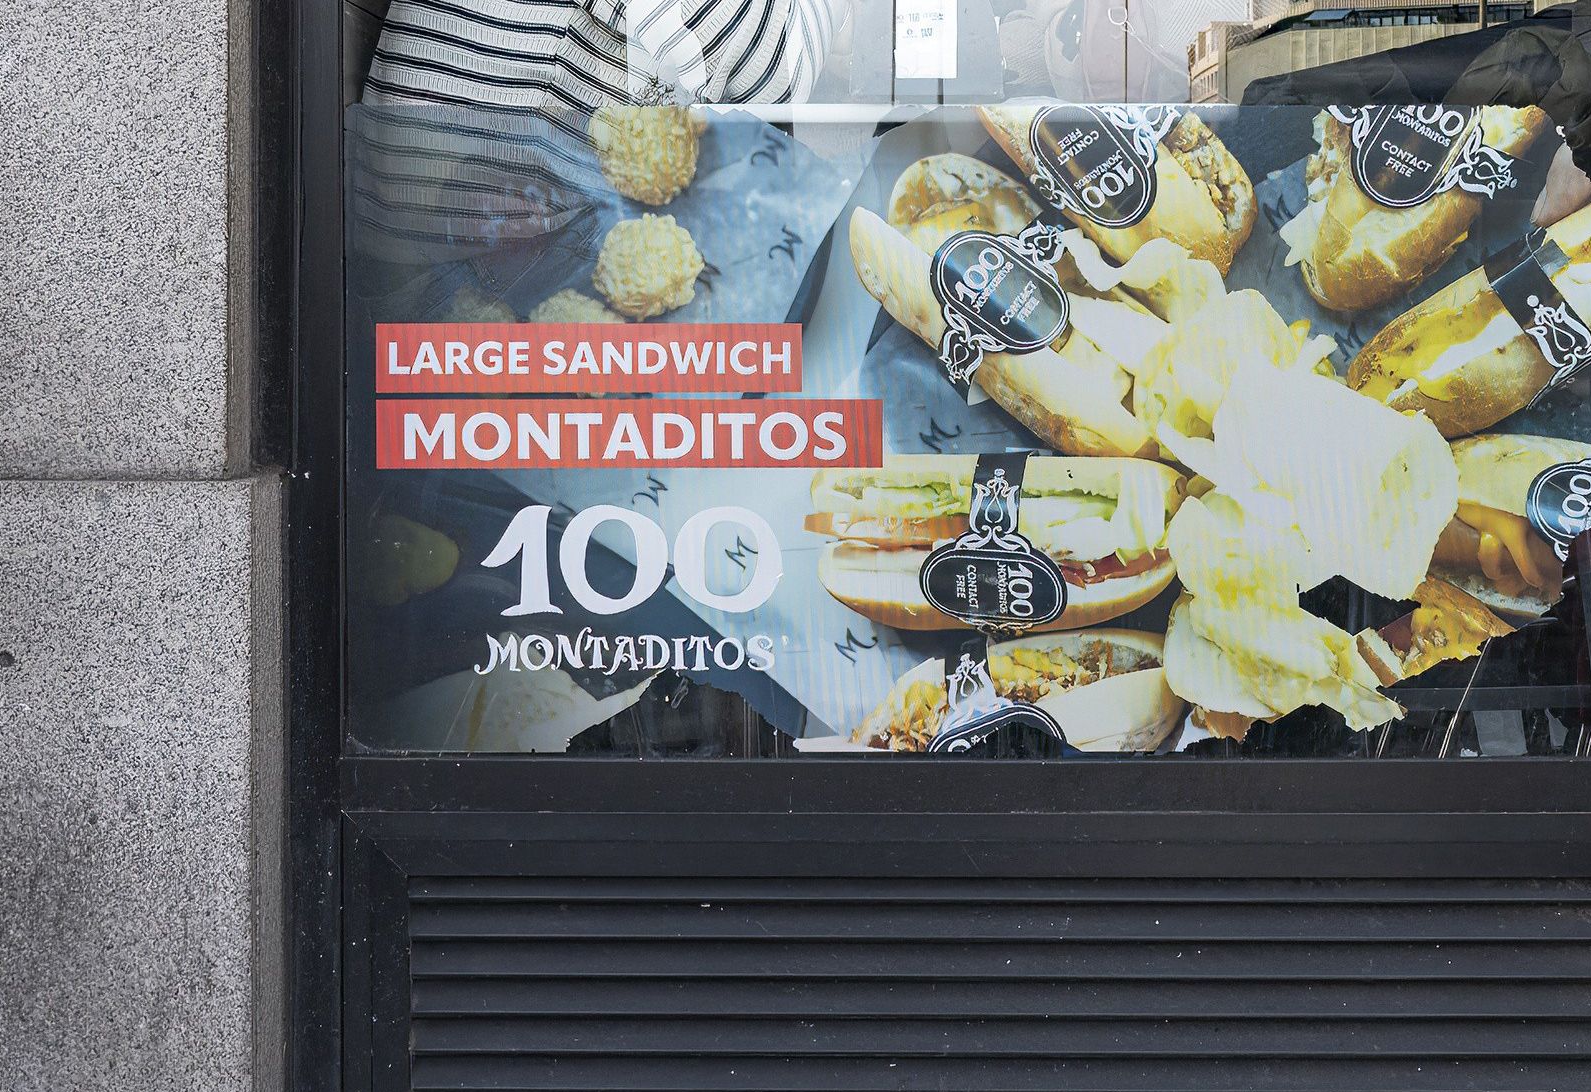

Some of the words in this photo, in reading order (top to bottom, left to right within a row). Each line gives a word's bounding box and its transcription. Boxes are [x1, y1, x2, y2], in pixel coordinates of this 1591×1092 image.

[1057, 128, 1083, 149] FREE
[1057, 130, 1100, 165] CONTACT
[1381, 140, 1432, 173] CONTACT
[1081, 161, 1134, 208] 100
[1385, 156, 1415, 178] FREE
[955, 247, 1005, 305] 100
[388, 341, 530, 375] LARGE
[543, 341, 791, 375] SANDWICH
[403, 412, 847, 461] MONTADITOS
[480, 504, 784, 617] 100
[955, 574, 966, 599] FREE
[966, 564, 979, 609] CONTACT
[1007, 563, 1034, 617] 100
[474, 627, 777, 676] MONTADITOS
